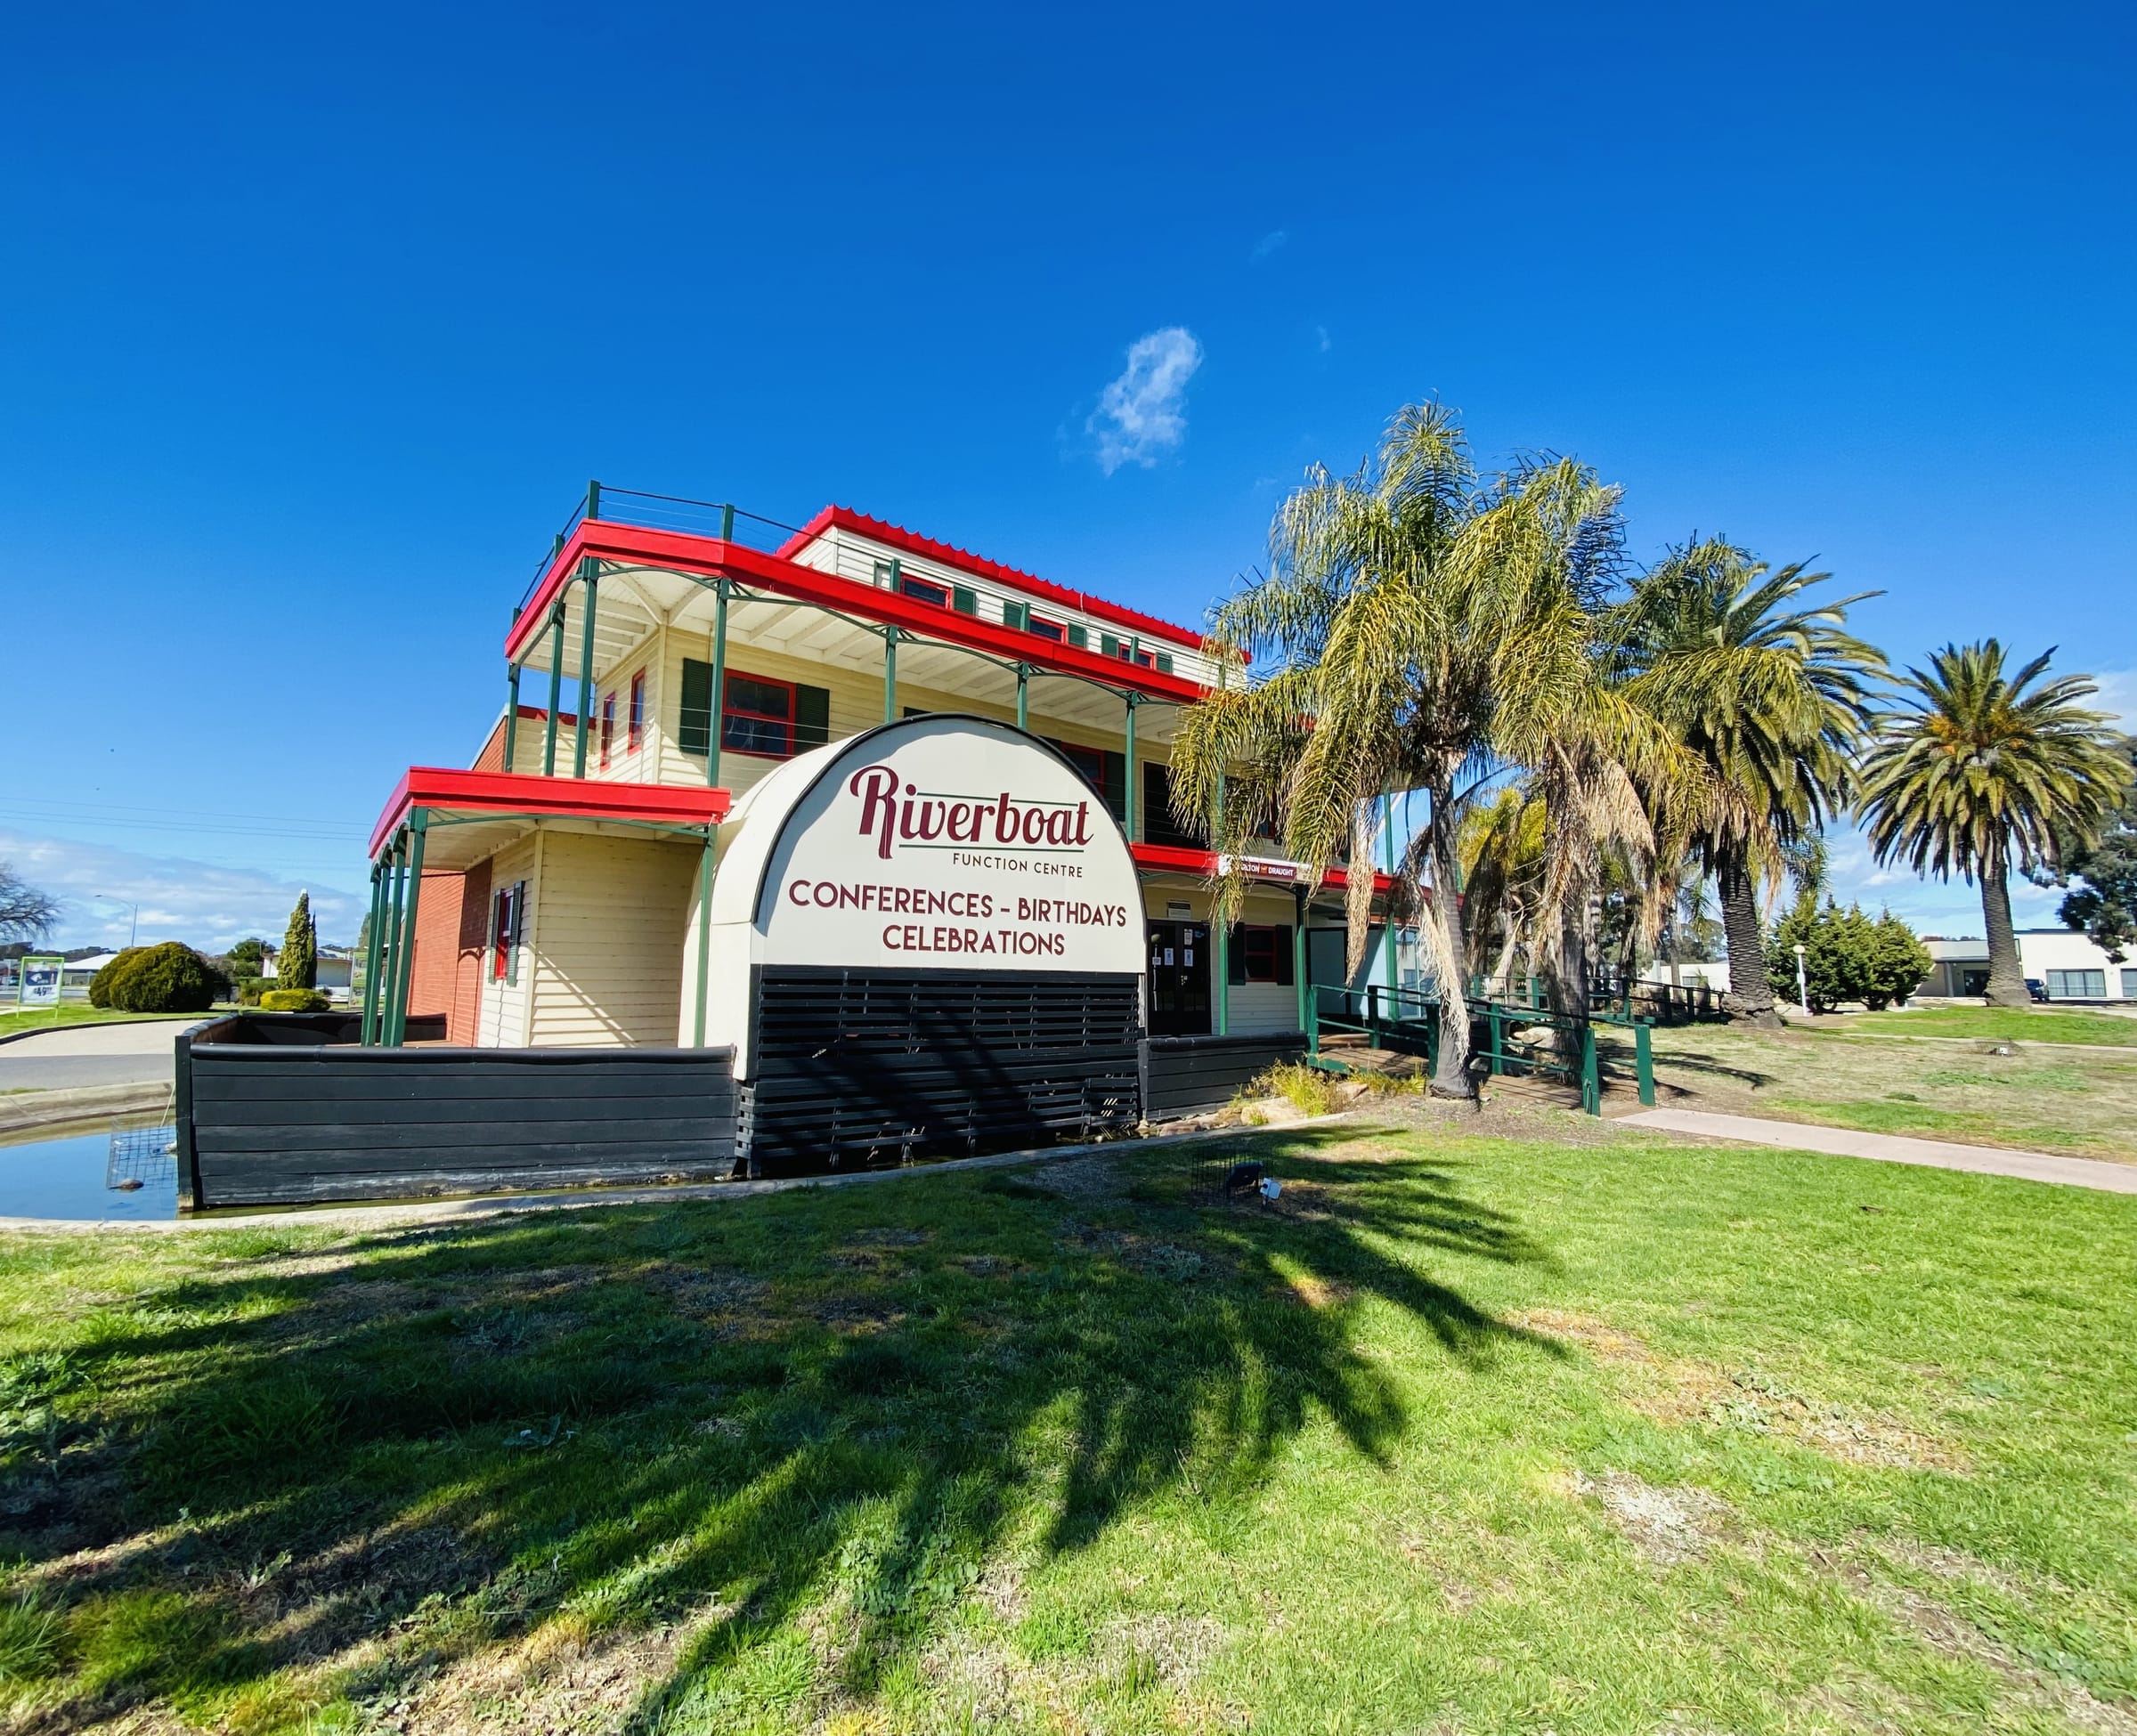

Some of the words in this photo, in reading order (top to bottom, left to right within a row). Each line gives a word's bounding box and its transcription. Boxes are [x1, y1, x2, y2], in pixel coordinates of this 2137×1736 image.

[849, 765, 1093, 859] Riverboat
[953, 853, 1028, 872] FUNCTION
[1034, 862, 1083, 878] CENTRE
[1268, 867, 1294, 876] DRAUGHT
[789, 880, 993, 918] CONFERENCES
[1018, 897, 1125, 927] BIRTHDAYS
[882, 924, 1065, 955] CELEBRATIONS
